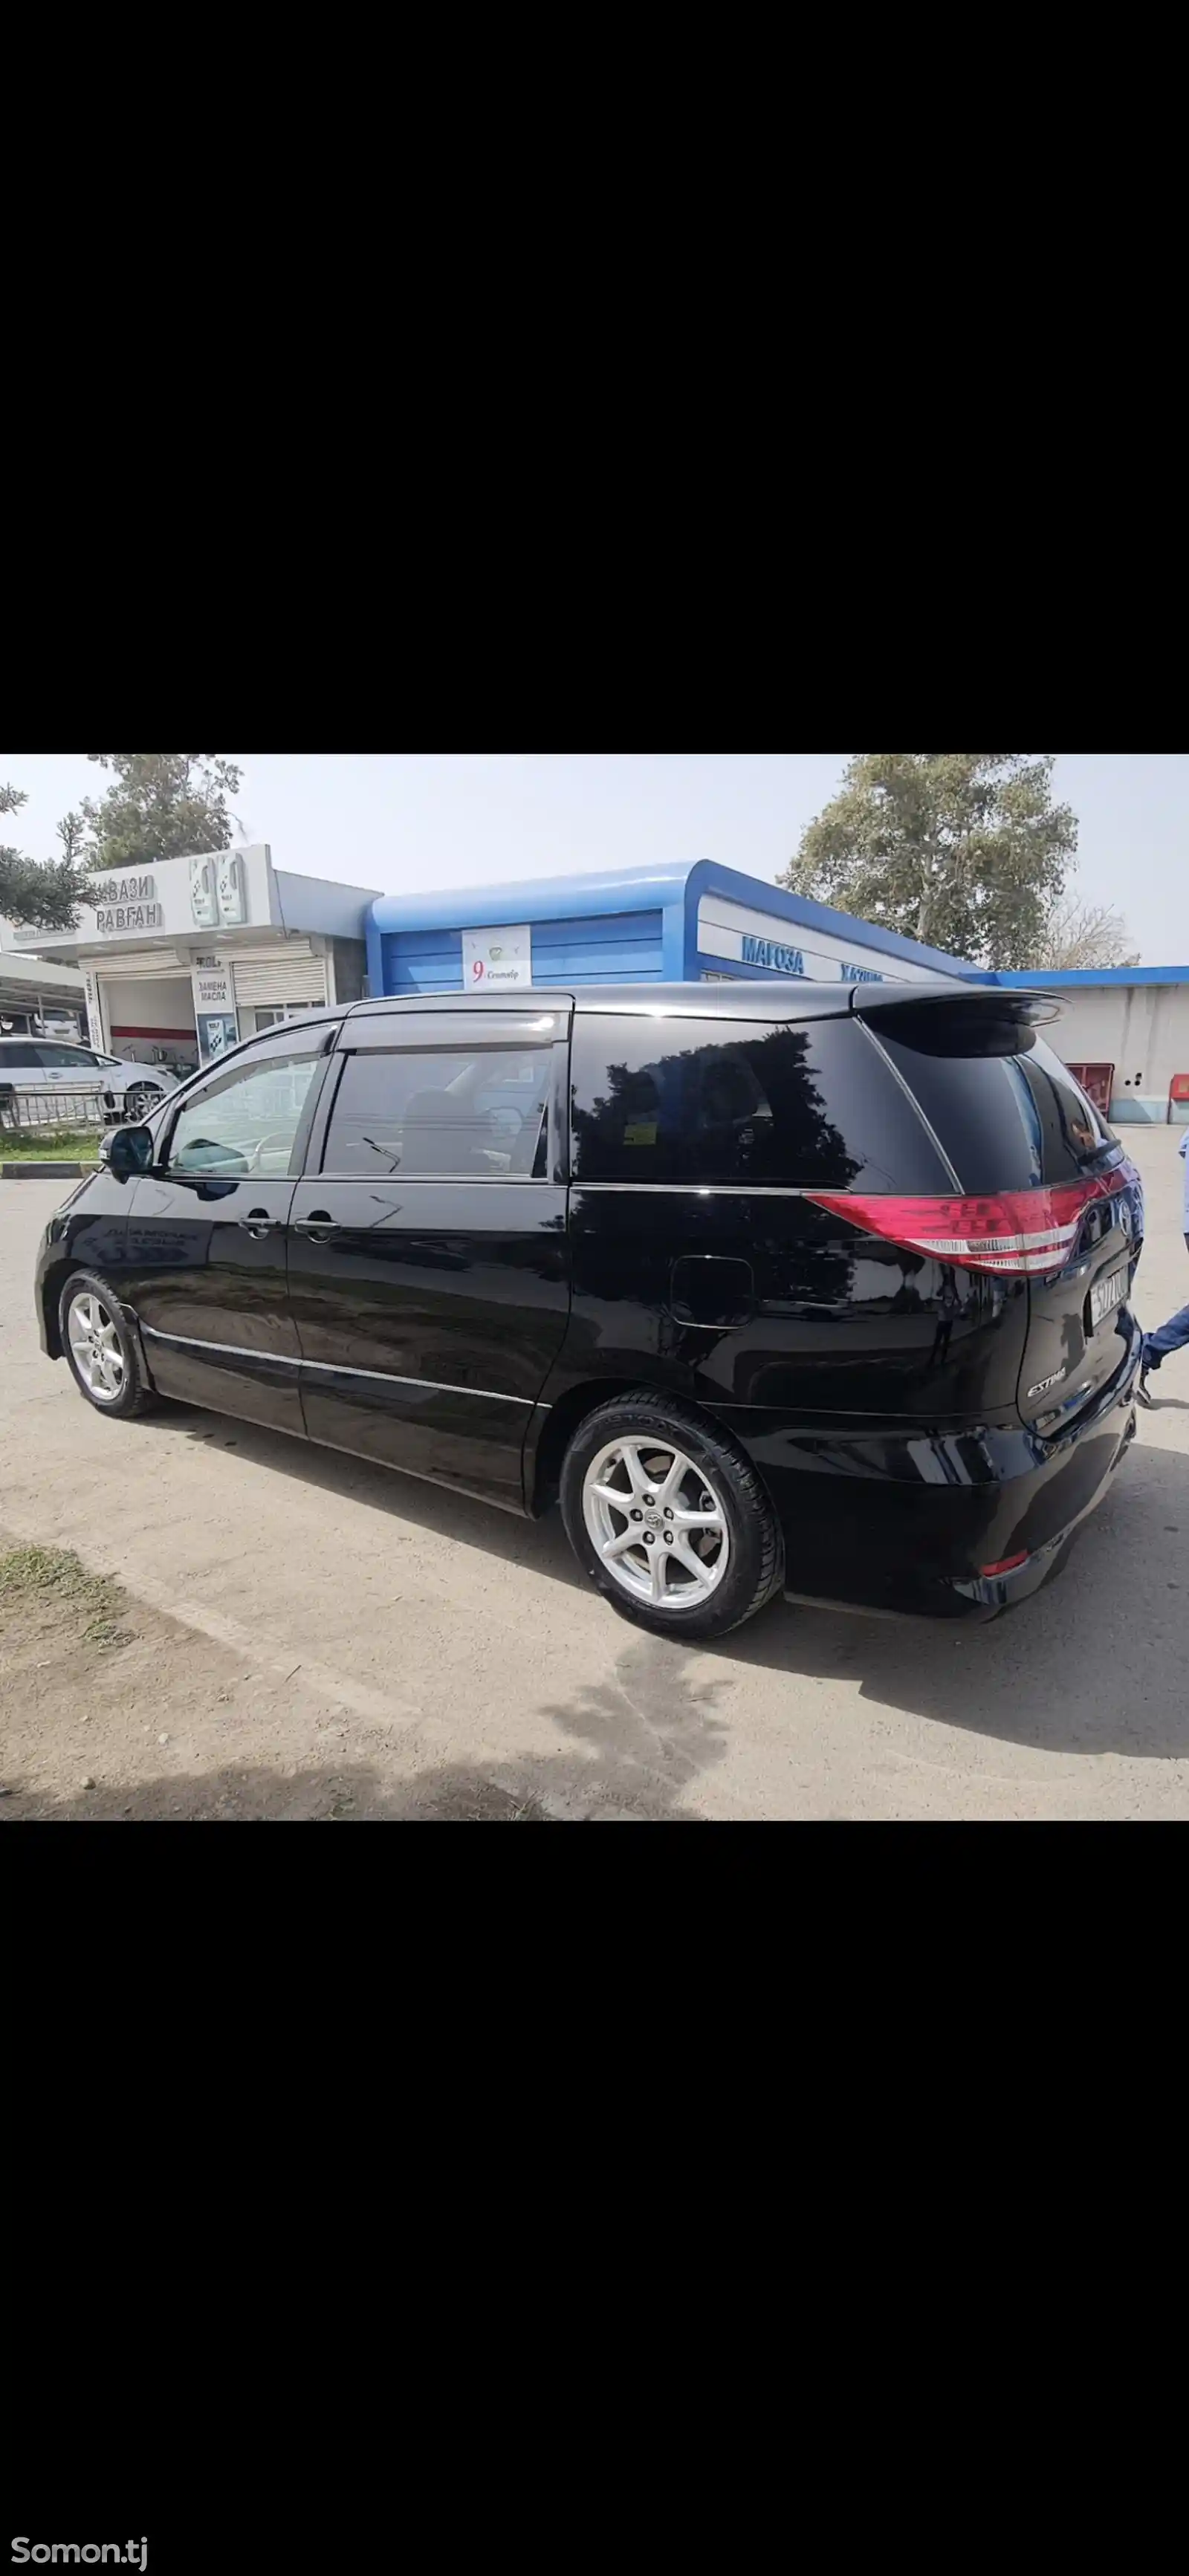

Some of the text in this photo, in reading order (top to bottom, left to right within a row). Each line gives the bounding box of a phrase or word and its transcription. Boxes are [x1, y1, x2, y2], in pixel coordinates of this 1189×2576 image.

[473, 960, 485, 984] 9
[198, 981, 227, 992] ЗАМЕНА
[201, 992, 226, 1001] МАСЛА
